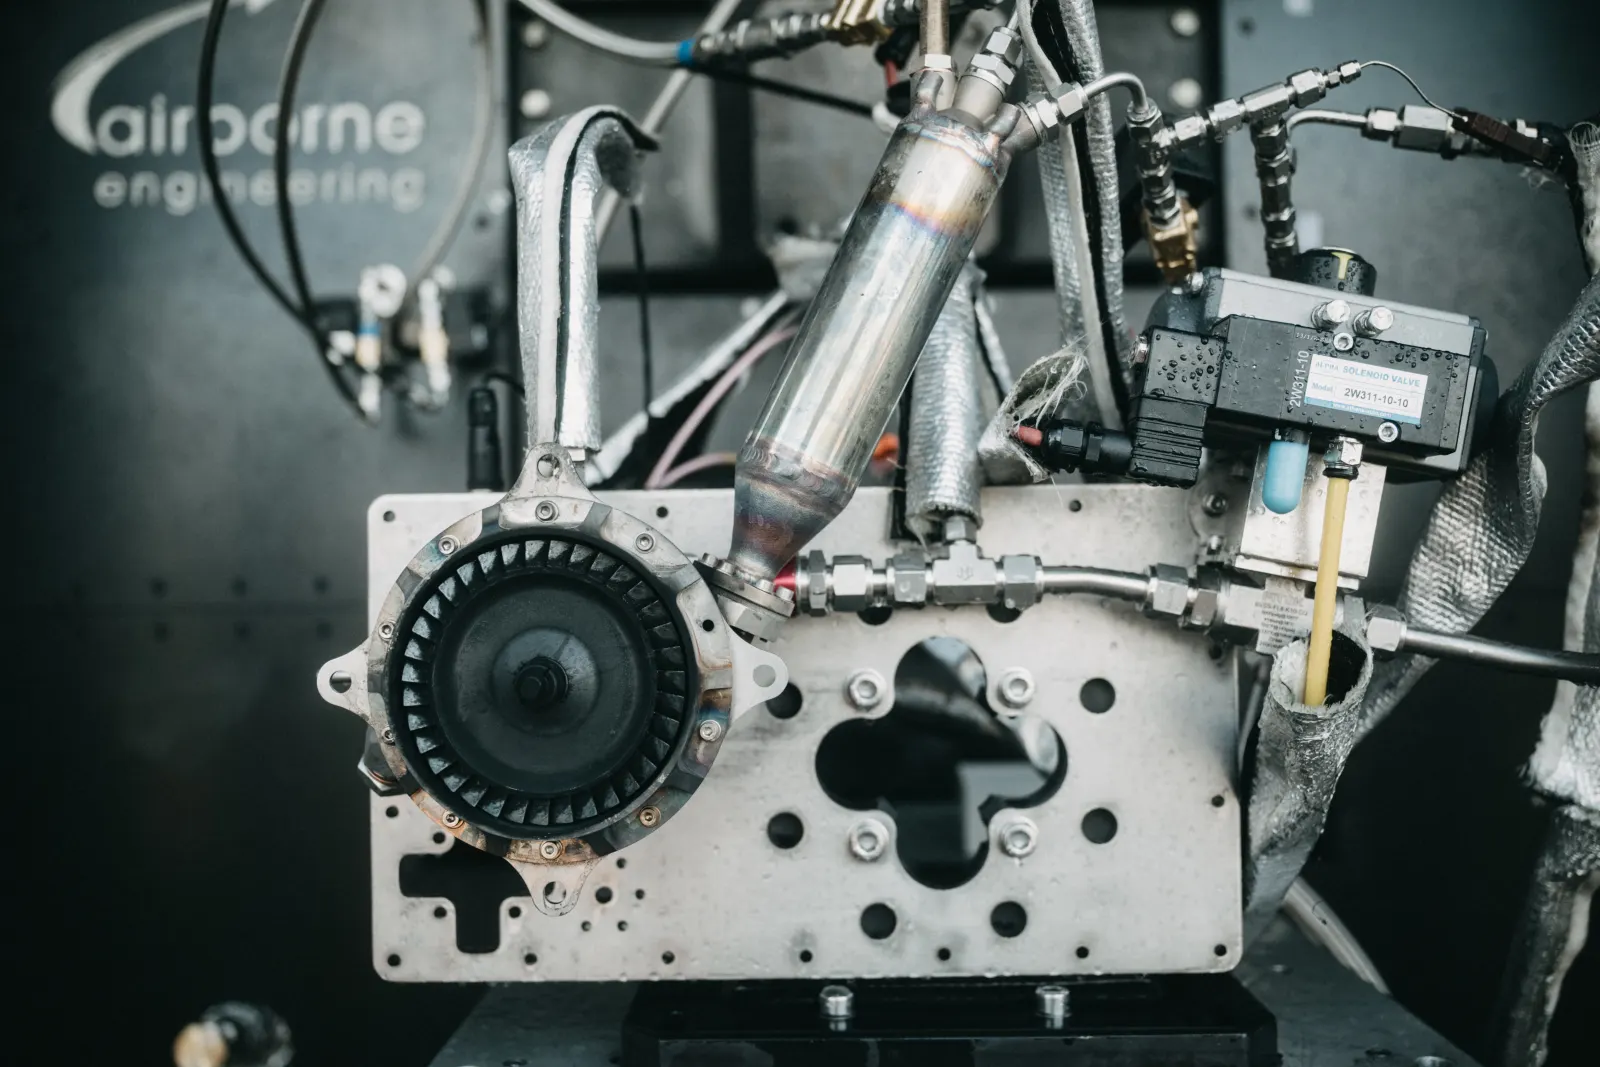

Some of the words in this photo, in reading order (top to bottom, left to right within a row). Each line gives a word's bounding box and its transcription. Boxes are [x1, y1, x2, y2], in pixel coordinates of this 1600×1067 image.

[97, 92, 426, 157] airborne
[1290, 350, 1310, 408] 2W311-10
[1343, 366, 1389, 381] SOLENOID
[1391, 375, 1421, 388] VALVE
[1344, 387, 1409, 408] 2W311-10-10
